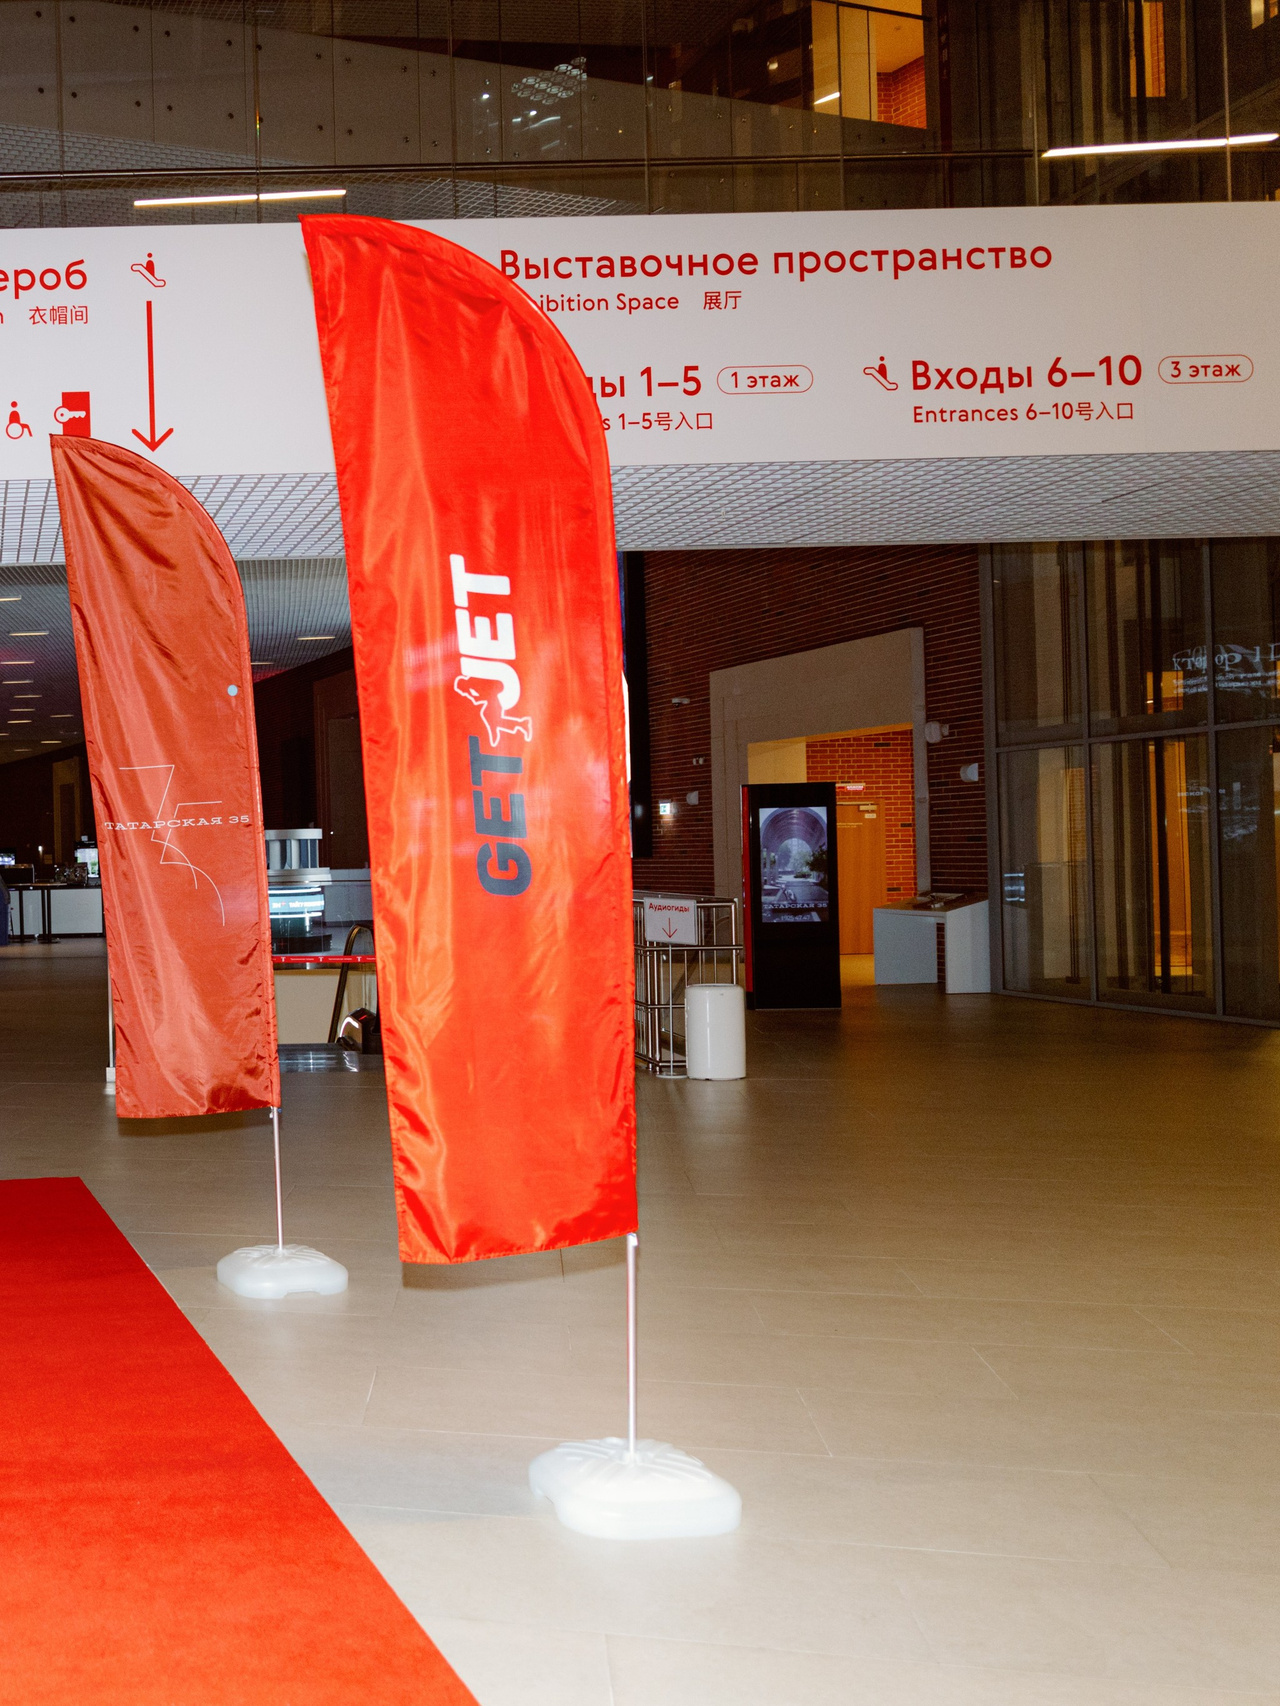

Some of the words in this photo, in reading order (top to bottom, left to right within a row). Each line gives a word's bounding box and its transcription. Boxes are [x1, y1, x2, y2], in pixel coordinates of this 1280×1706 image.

[500, 249, 759, 280] Выставочное
[773, 245, 1053, 282] пространство
[539, 293, 609, 313] ibition
[616, 292, 680, 314] Space
[702, 290, 742, 311] 展厅
[28, 305, 89, 326] 衣帽间
[730, 371, 739, 389] 1
[746, 371, 800, 388] этаж
[911, 359, 1033, 395] Входы
[1047, 354, 1143, 389] 6–10
[1170, 361, 1182, 378] 3
[1189, 361, 1242, 378] этаж
[640, 365, 702, 397] 1–5
[913, 404, 1019, 424] Entrances
[104, 816, 223, 831] ТАТАРСКАЯ
[228, 815, 250, 824] 35
[648, 902, 690, 914] Аудиогиды
